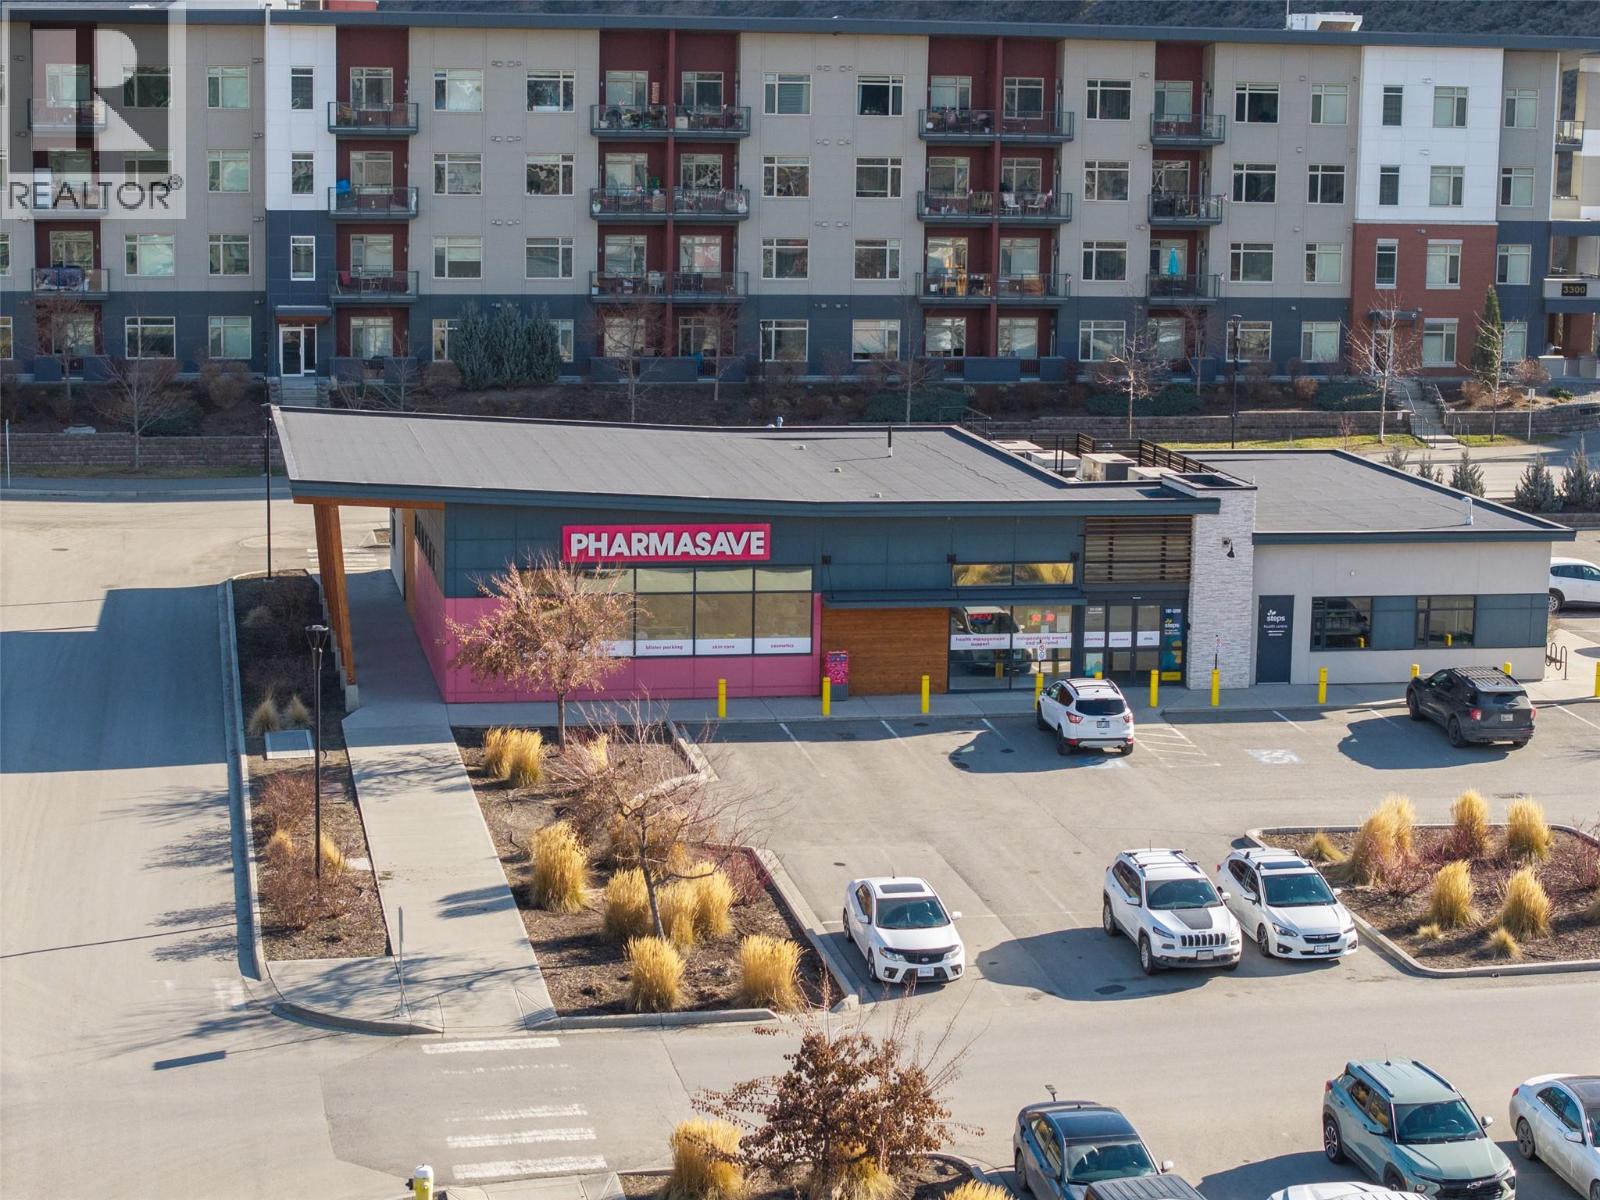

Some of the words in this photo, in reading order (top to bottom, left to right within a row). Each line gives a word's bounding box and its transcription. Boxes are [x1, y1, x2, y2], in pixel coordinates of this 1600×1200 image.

[1563, 286, 1585, 294] 3300
[570, 531, 765, 557] PHARMASAVE
[1266, 615, 1286, 624] steps
